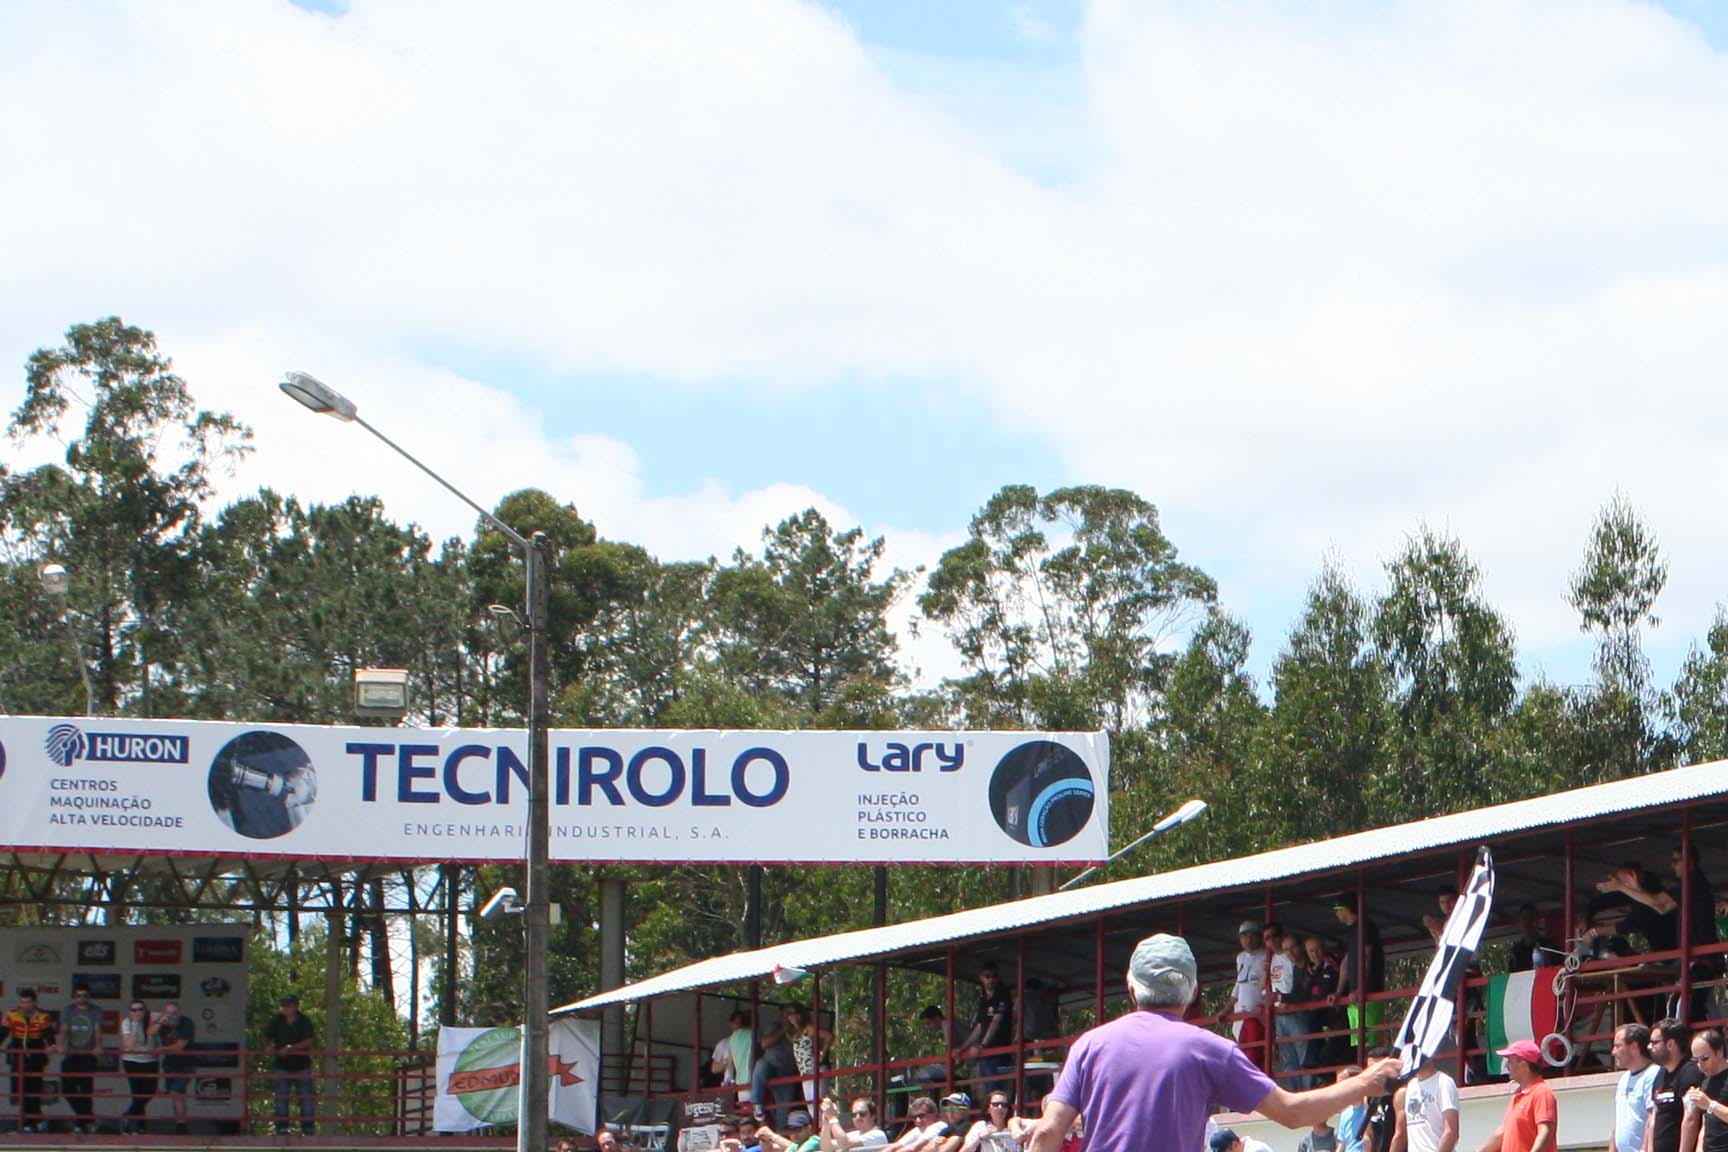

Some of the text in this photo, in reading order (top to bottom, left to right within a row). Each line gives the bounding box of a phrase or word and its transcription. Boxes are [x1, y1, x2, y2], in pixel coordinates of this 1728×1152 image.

[95, 736, 182, 761] HURON
[50, 778, 118, 792] CENTROS
[50, 796, 152, 812] MAQUINAÇÃO
[857, 792, 920, 808] INJEÇÃO
[50, 813, 184, 828] ALTA VELOCIDADE
[857, 808, 927, 823] PLÁSTICO
[403, 822, 525, 838] ENGENHARI
[689, 827, 730, 840] S.A.
[857, 828, 950, 841] E BORRACHA
